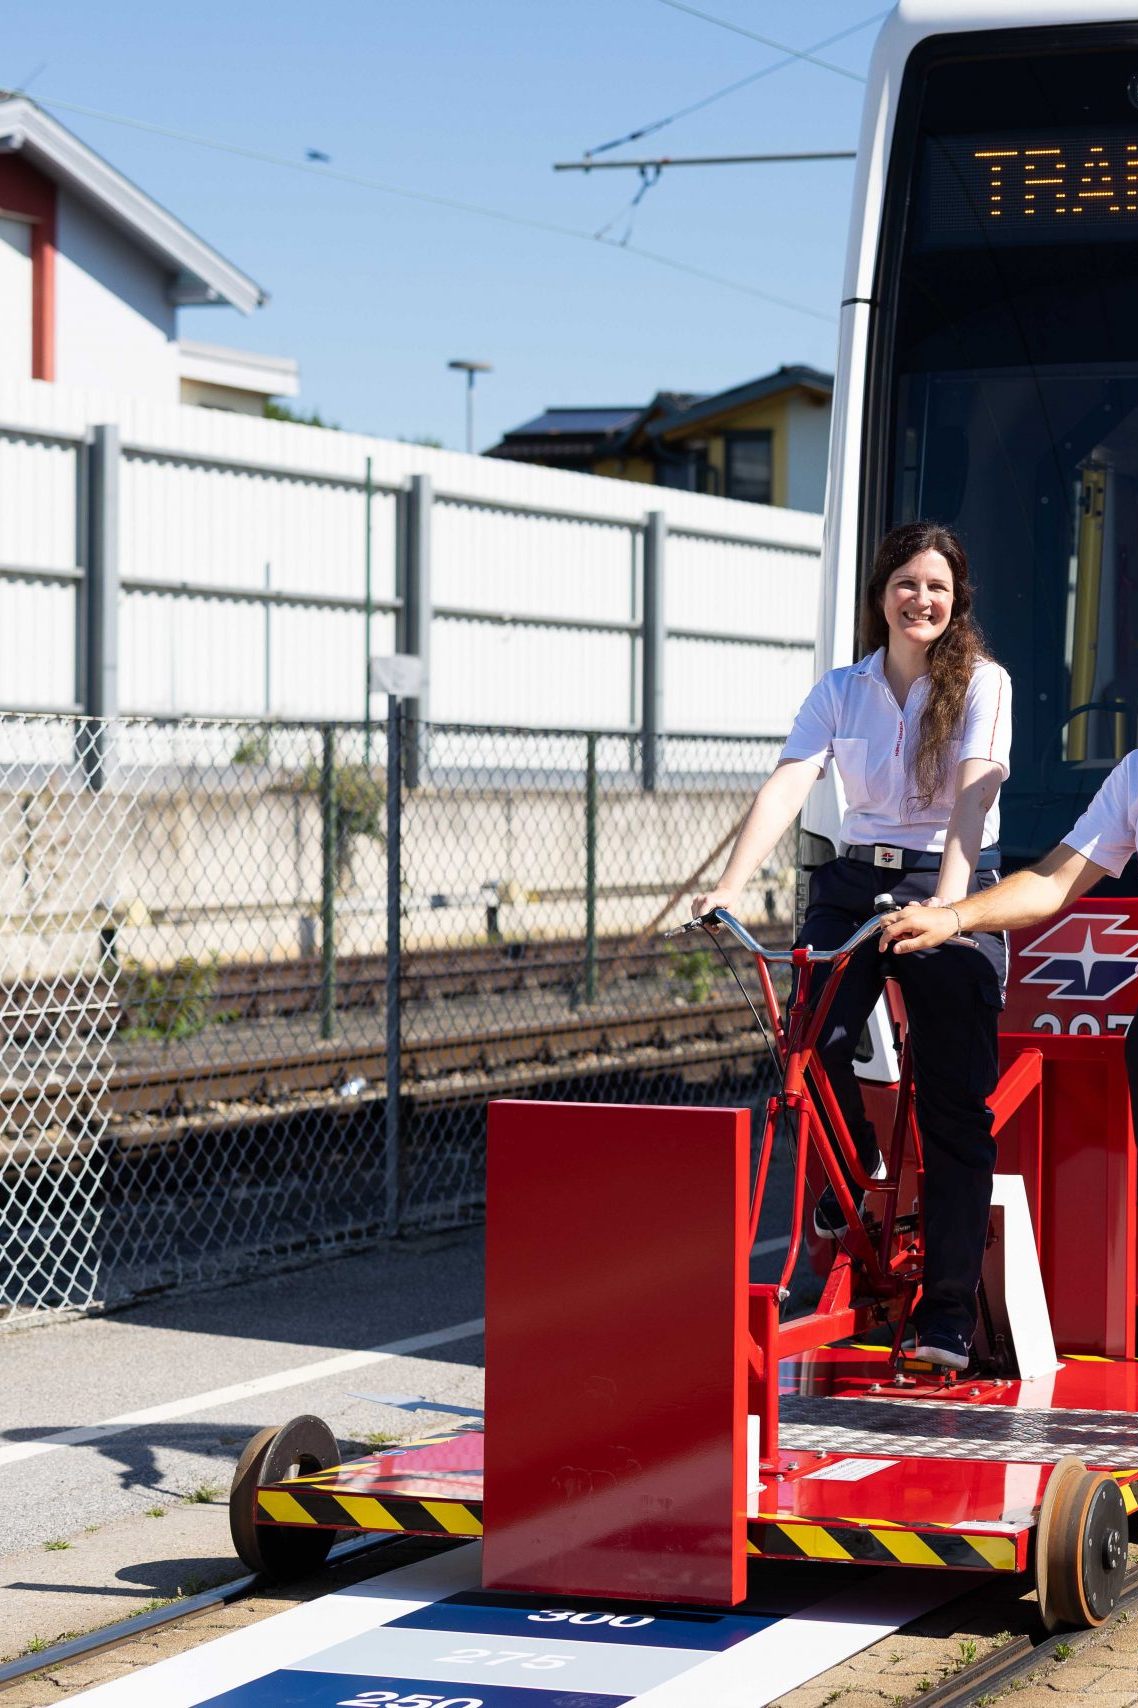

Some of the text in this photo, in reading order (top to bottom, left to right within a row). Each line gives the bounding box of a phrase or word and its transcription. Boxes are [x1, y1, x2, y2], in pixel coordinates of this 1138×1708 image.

[527, 1608, 656, 1628] 300
[431, 1648, 577, 1670] 275
[336, 1691, 485, 1708] 250
